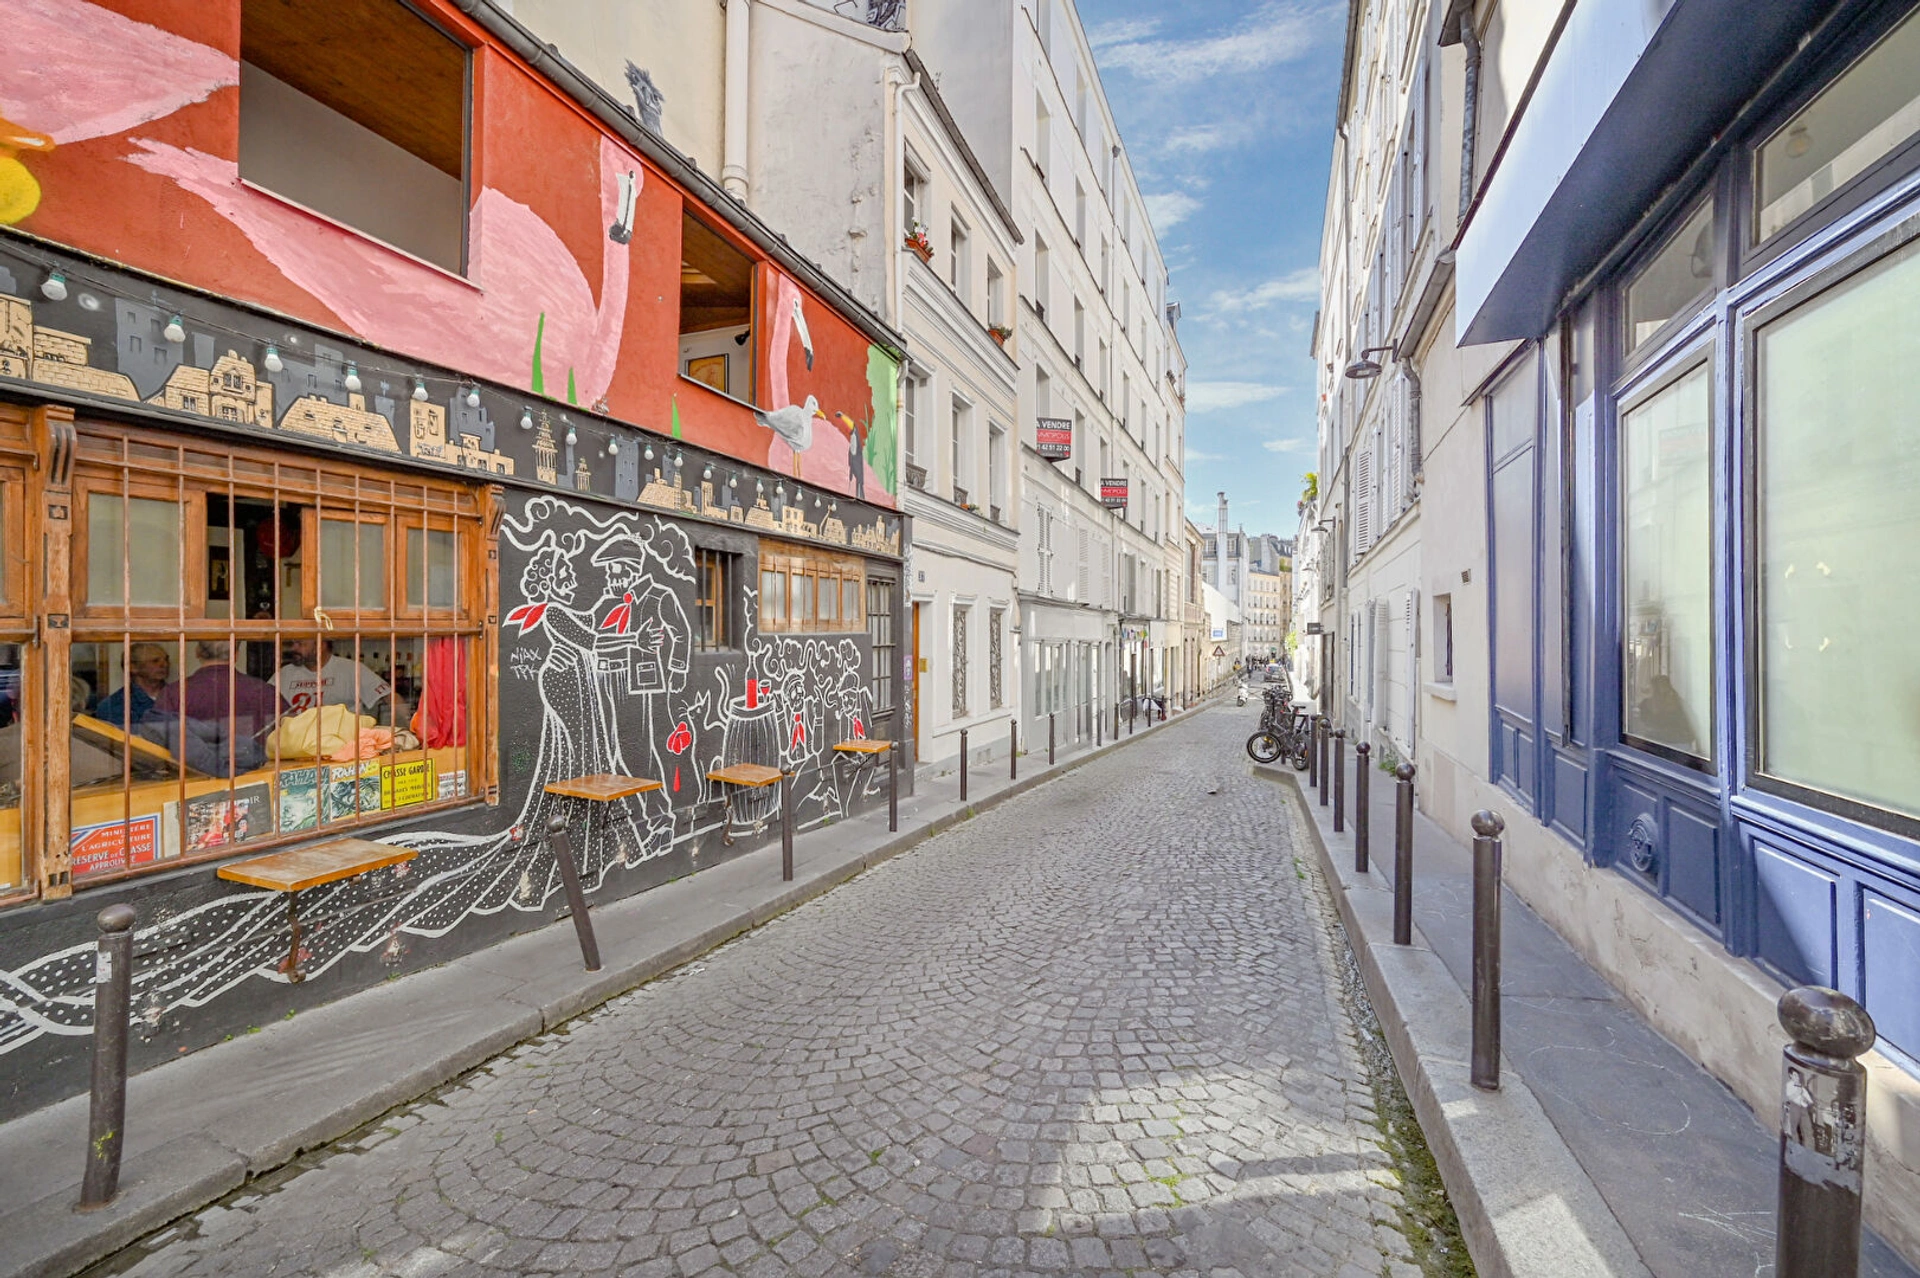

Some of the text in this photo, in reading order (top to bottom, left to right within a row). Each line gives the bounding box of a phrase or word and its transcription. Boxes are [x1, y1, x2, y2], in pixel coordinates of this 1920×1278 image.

[1041, 420, 1071, 430] VENDRE
[331, 760, 371, 780] RAHN
[408, 763, 430, 776] GARDE
[81, 833, 151, 852] L'AGRICUTURE
[119, 842, 152, 857] CASSE
[89, 855, 137, 872] APPROUVE
